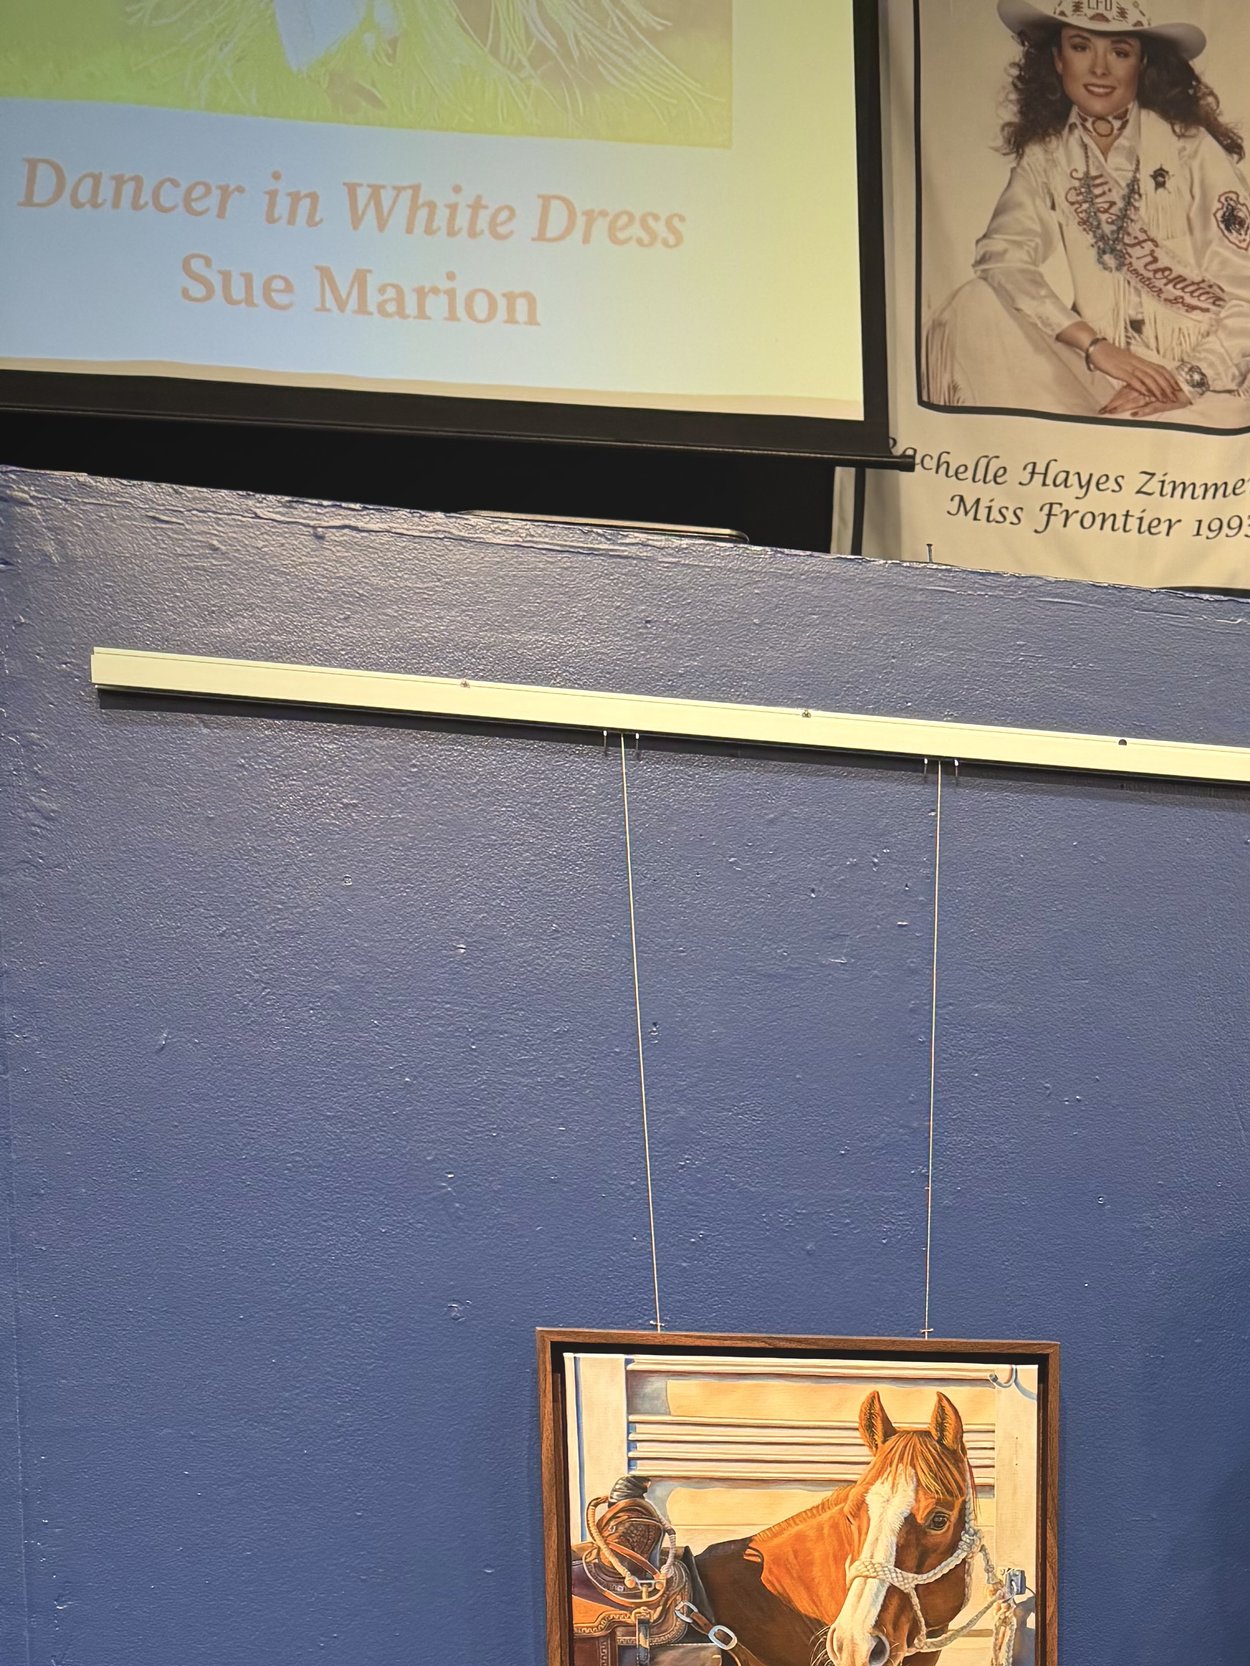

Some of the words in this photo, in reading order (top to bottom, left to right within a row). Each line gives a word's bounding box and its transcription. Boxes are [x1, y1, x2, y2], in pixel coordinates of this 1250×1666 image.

[17, 157, 246, 220] Dancer
[263, 170, 323, 228] in
[342, 182, 517, 241] White
[530, 193, 687, 249] Dress
[181, 252, 295, 311] Sue
[313, 265, 541, 327] Marion
[1018, 458, 1125, 500] Hayes
[946, 493, 1024, 526] Miss
[1033, 501, 1182, 537] Frontier
